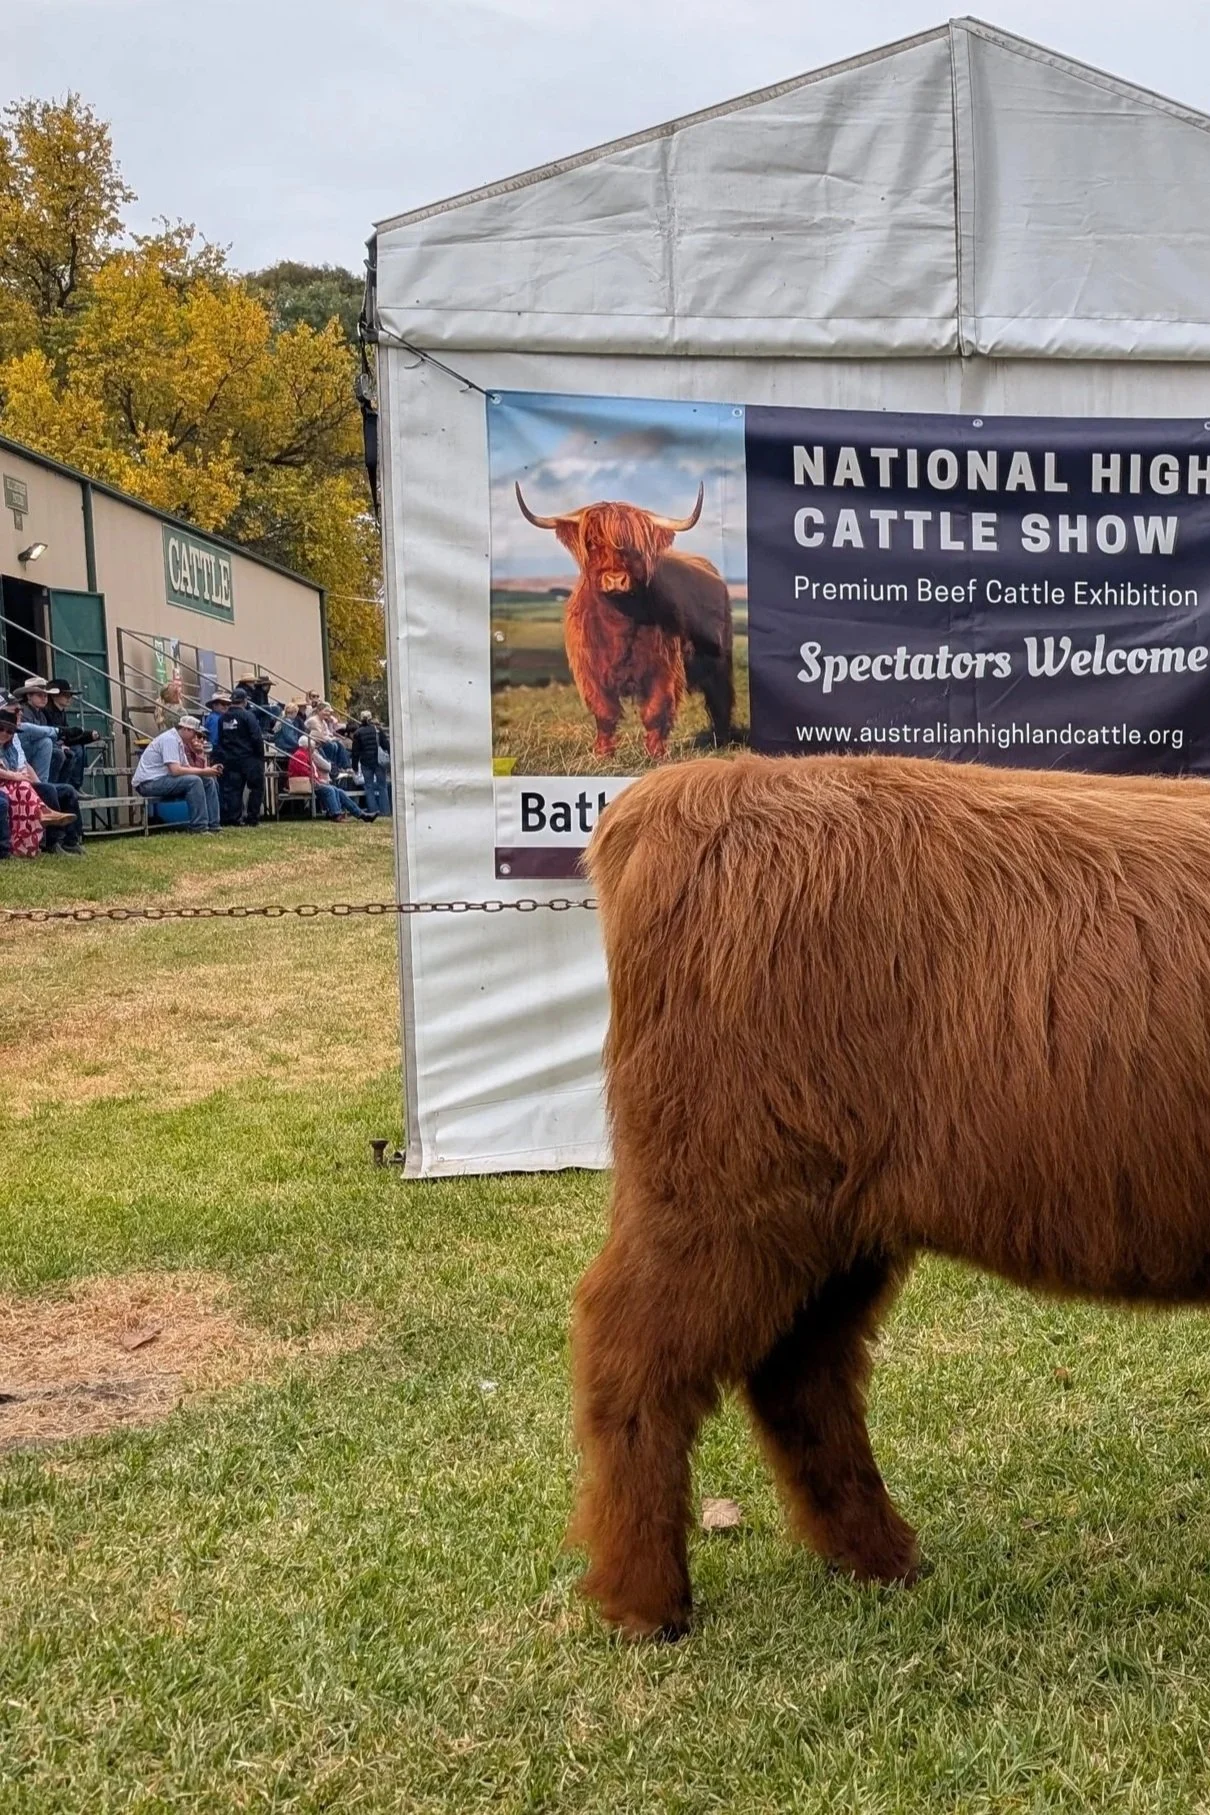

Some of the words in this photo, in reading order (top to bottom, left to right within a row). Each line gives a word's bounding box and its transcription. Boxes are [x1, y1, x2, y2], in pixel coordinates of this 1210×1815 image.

[793, 445, 1069, 492] NATIONAL
[793, 507, 998, 551] CATTLE
[1021, 513, 1178, 554] SHOW
[169, 537, 231, 607] CATTLE
[794, 576, 908, 601] Premium
[917, 578, 977, 603] Beef
[986, 580, 1065, 605] Cattle
[1074, 581, 1198, 606] Exhibition
[797, 641, 1012, 694] Spectators
[1023, 634, 1209, 677] Welcome
[796, 722, 1184, 749] www.australianhighlandcattle.org
